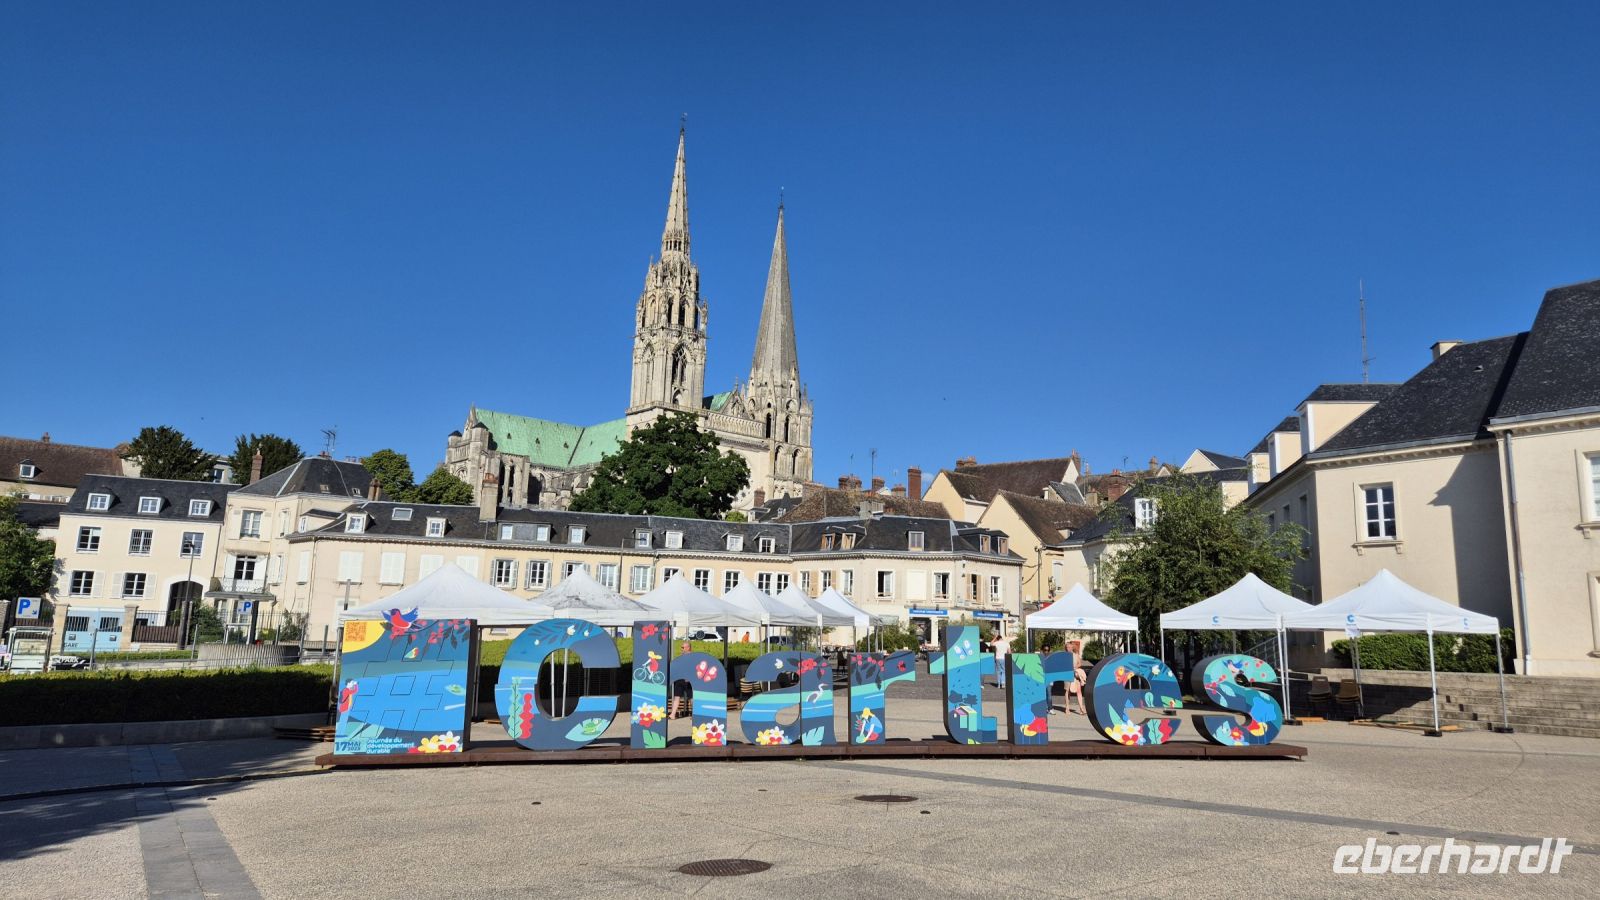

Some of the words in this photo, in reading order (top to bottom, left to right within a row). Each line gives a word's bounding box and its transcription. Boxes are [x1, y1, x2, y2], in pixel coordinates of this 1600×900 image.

[18, 599, 30, 614] P
[244, 602, 251, 612] P
[336, 742, 347, 751] 17
